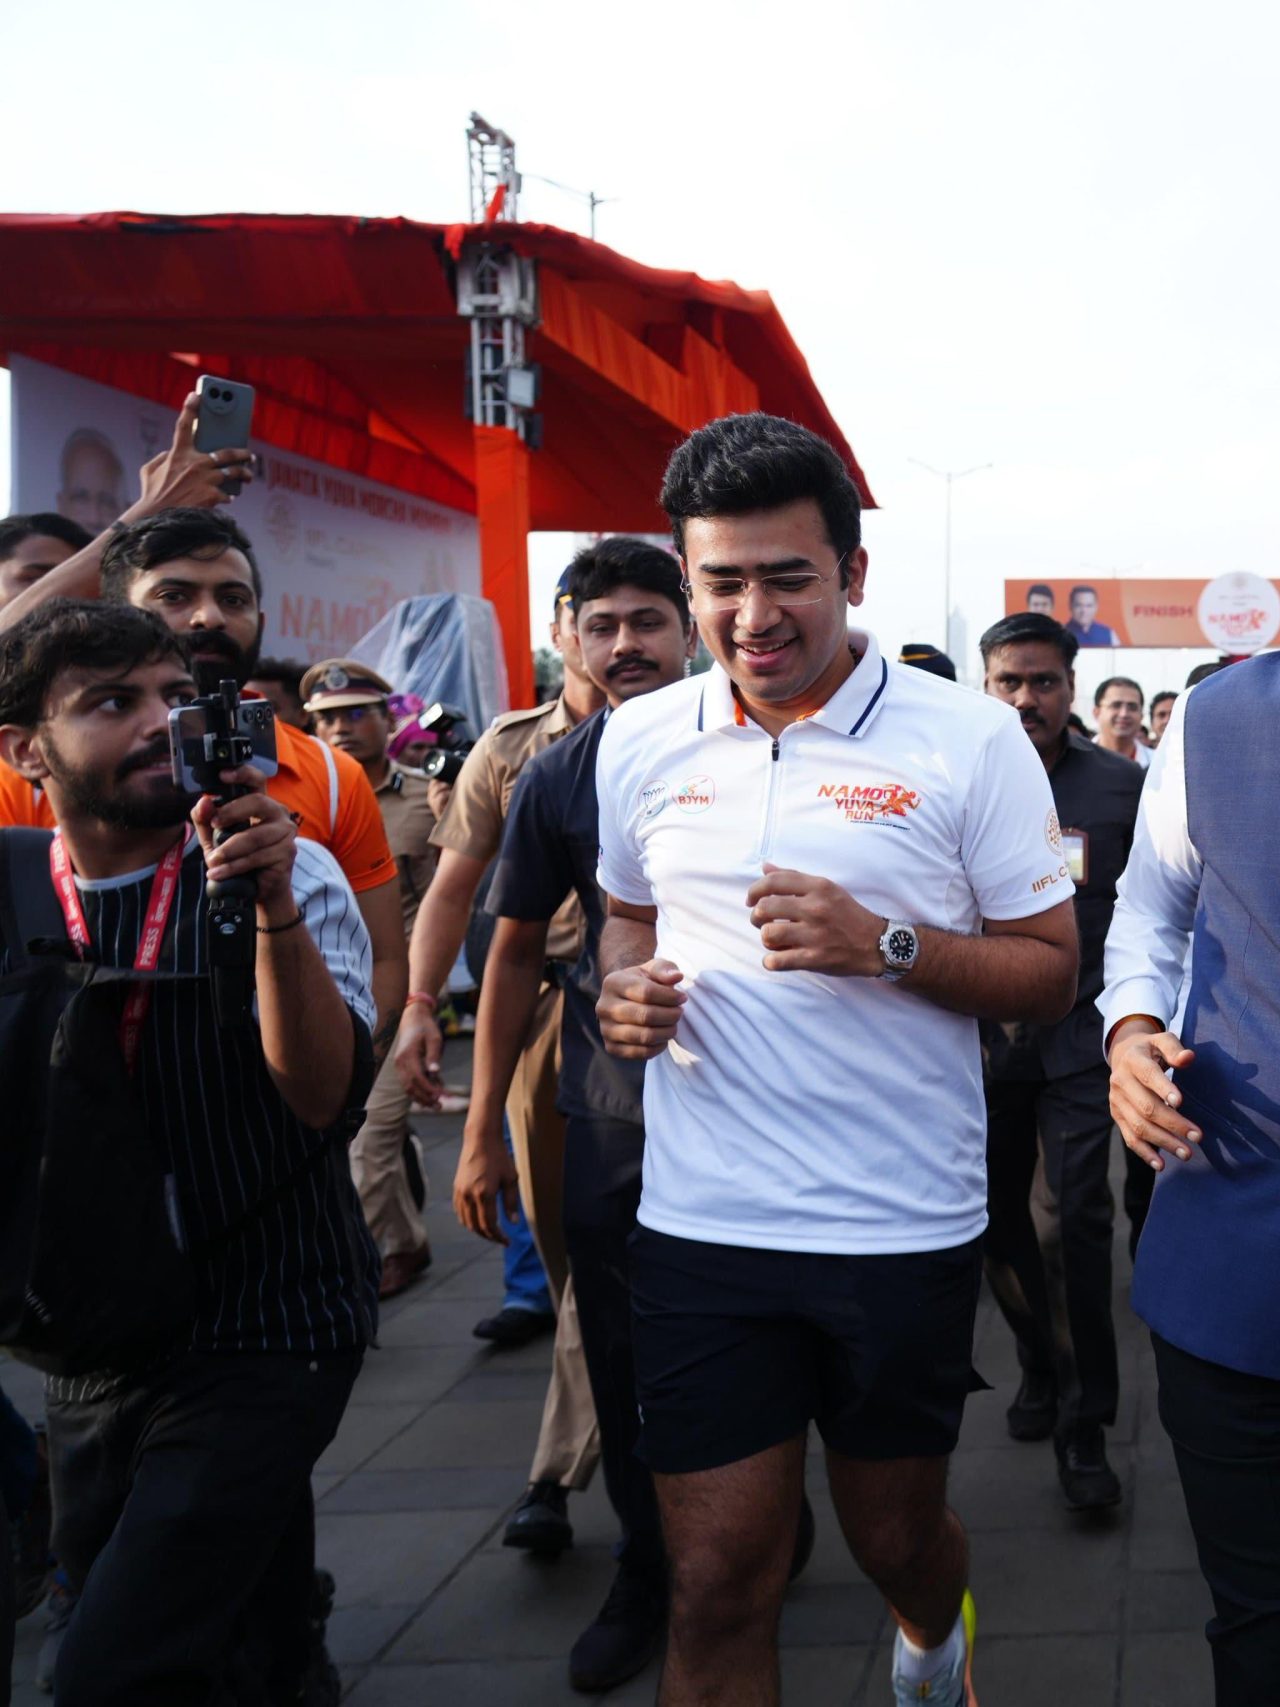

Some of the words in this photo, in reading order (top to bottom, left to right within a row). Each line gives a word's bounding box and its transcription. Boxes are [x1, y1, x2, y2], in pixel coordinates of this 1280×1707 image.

[1133, 605, 1193, 618] FINISH
[817, 784, 884, 801] NAMO
[678, 795, 709, 805] BJYM
[835, 799, 875, 811] YUVA
[845, 810, 875, 821] RUN
[1032, 874, 1058, 893] IIFL
[140, 928, 159, 966] PRESS
